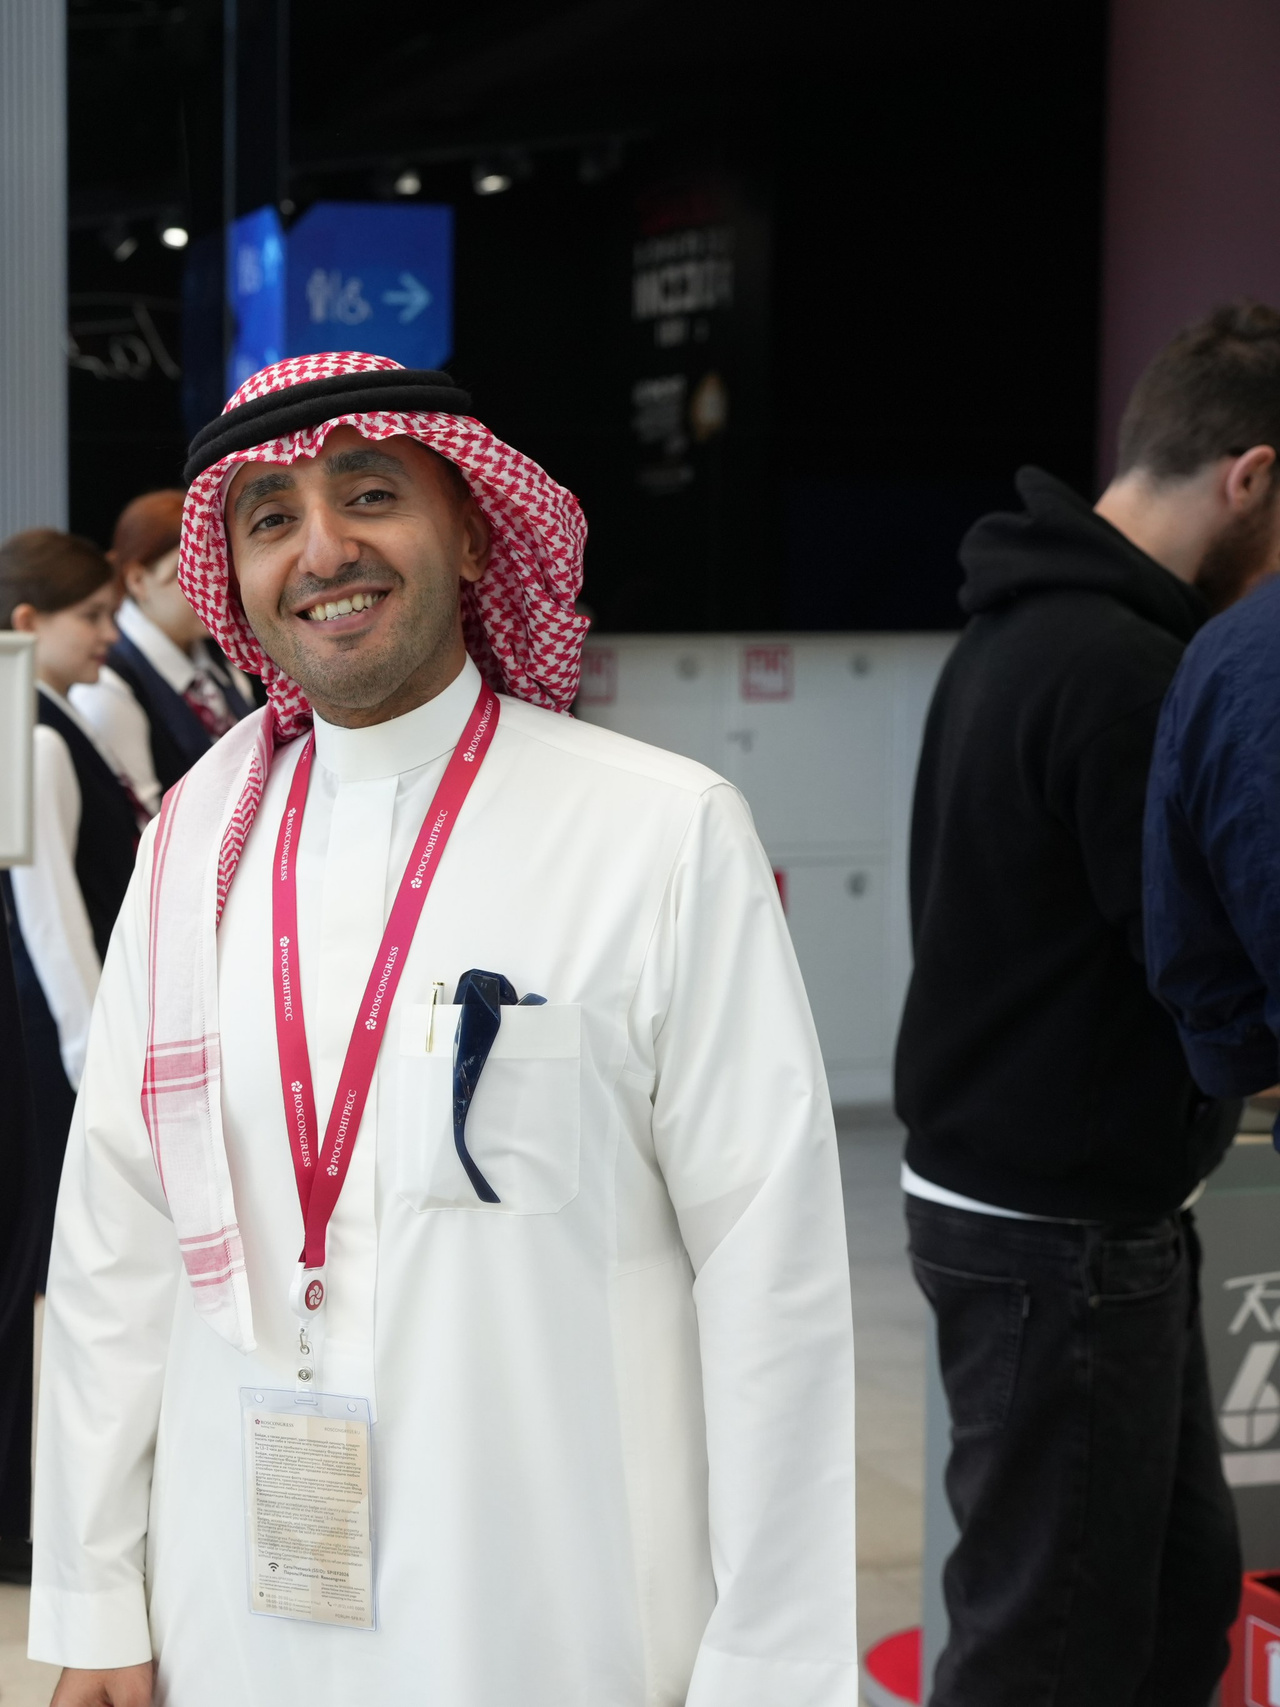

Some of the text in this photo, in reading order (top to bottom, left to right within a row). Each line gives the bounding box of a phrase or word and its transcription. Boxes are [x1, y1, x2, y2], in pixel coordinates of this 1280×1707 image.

[471, 698, 495, 754] ROSCONGRESS
[281, 818, 294, 881] ROSCONGRESS
[415, 809, 449, 878] РОСКОНГРЕСС
[281, 948, 294, 1021] РОСКОНГРЕСС
[370, 946, 399, 1018] ROSCONGRESS
[293, 1093, 312, 1168] ROSCONGRESS
[330, 1089, 357, 1164] РОСКОНГРЕСС
